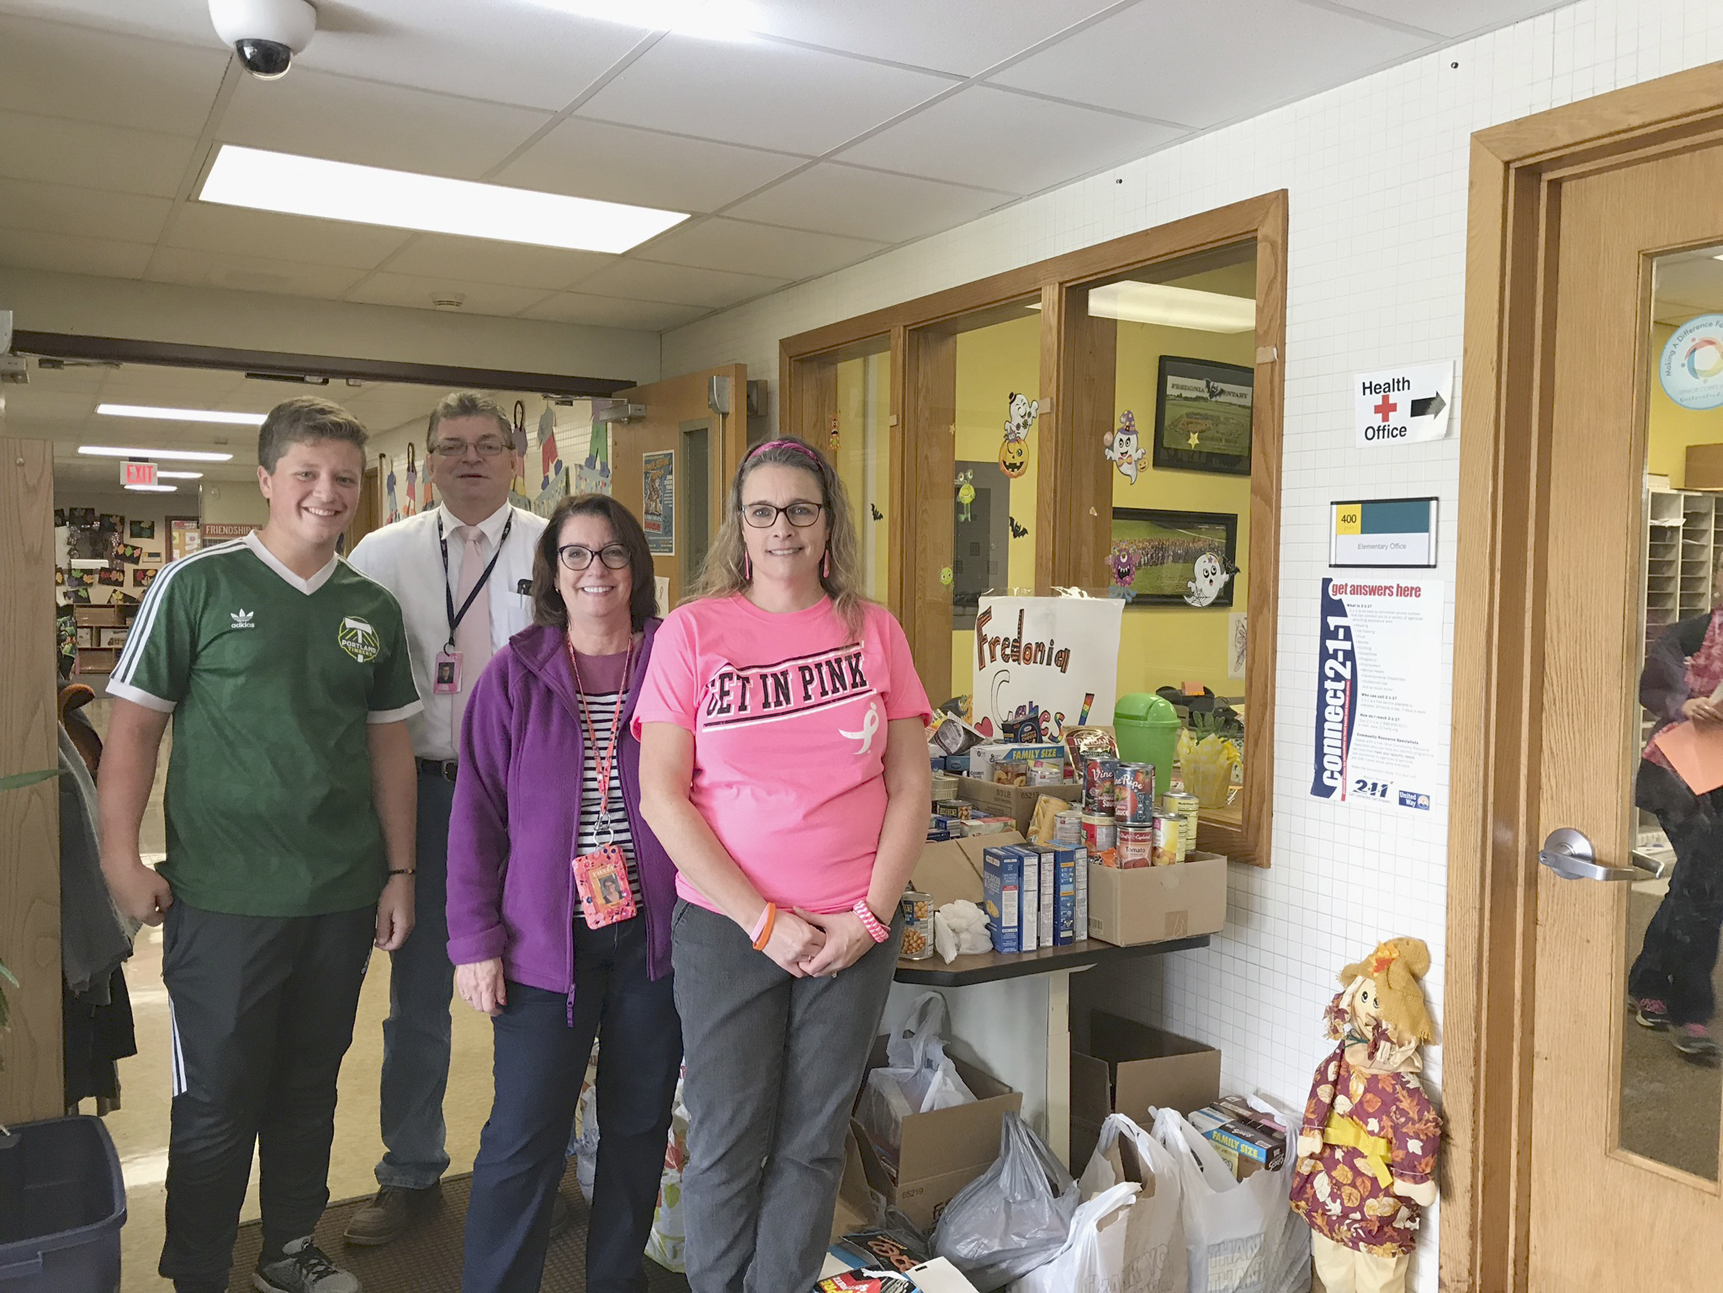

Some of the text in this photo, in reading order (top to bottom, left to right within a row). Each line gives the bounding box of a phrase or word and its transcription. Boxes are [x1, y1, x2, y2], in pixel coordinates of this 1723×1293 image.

[1677, 321, 1713, 342] Difference
[1171, 383, 1205, 393] FREDONIA
[1362, 376, 1411, 396] Health
[1364, 424, 1408, 441] Office
[126, 464, 154, 484] EXIT
[1341, 514, 1357, 524] 400
[205, 525, 251, 535] FRIENDSHIP
[1357, 542, 1407, 551] Elementary Office
[1332, 583, 1421, 598] get answers here
[341, 639, 376, 653] PORTLAND
[976, 606, 1071, 674] Fredonia
[1324, 616, 1351, 679] 2-1-1
[759, 669, 793, 711] IN
[798, 651, 870, 702] PINK
[1322, 679, 1345, 787] connect
[1013, 748, 1057, 760] FAMILY SIZE
[1091, 768, 1113, 781] Vine
[1122, 774, 1144, 790] Ripe
[1399, 791, 1416, 807] United Way
[1212, 1130, 1239, 1149] FAMILY
[1240, 1143, 1258, 1158] SIZE
[901, 1187, 924, 1199] 65219
